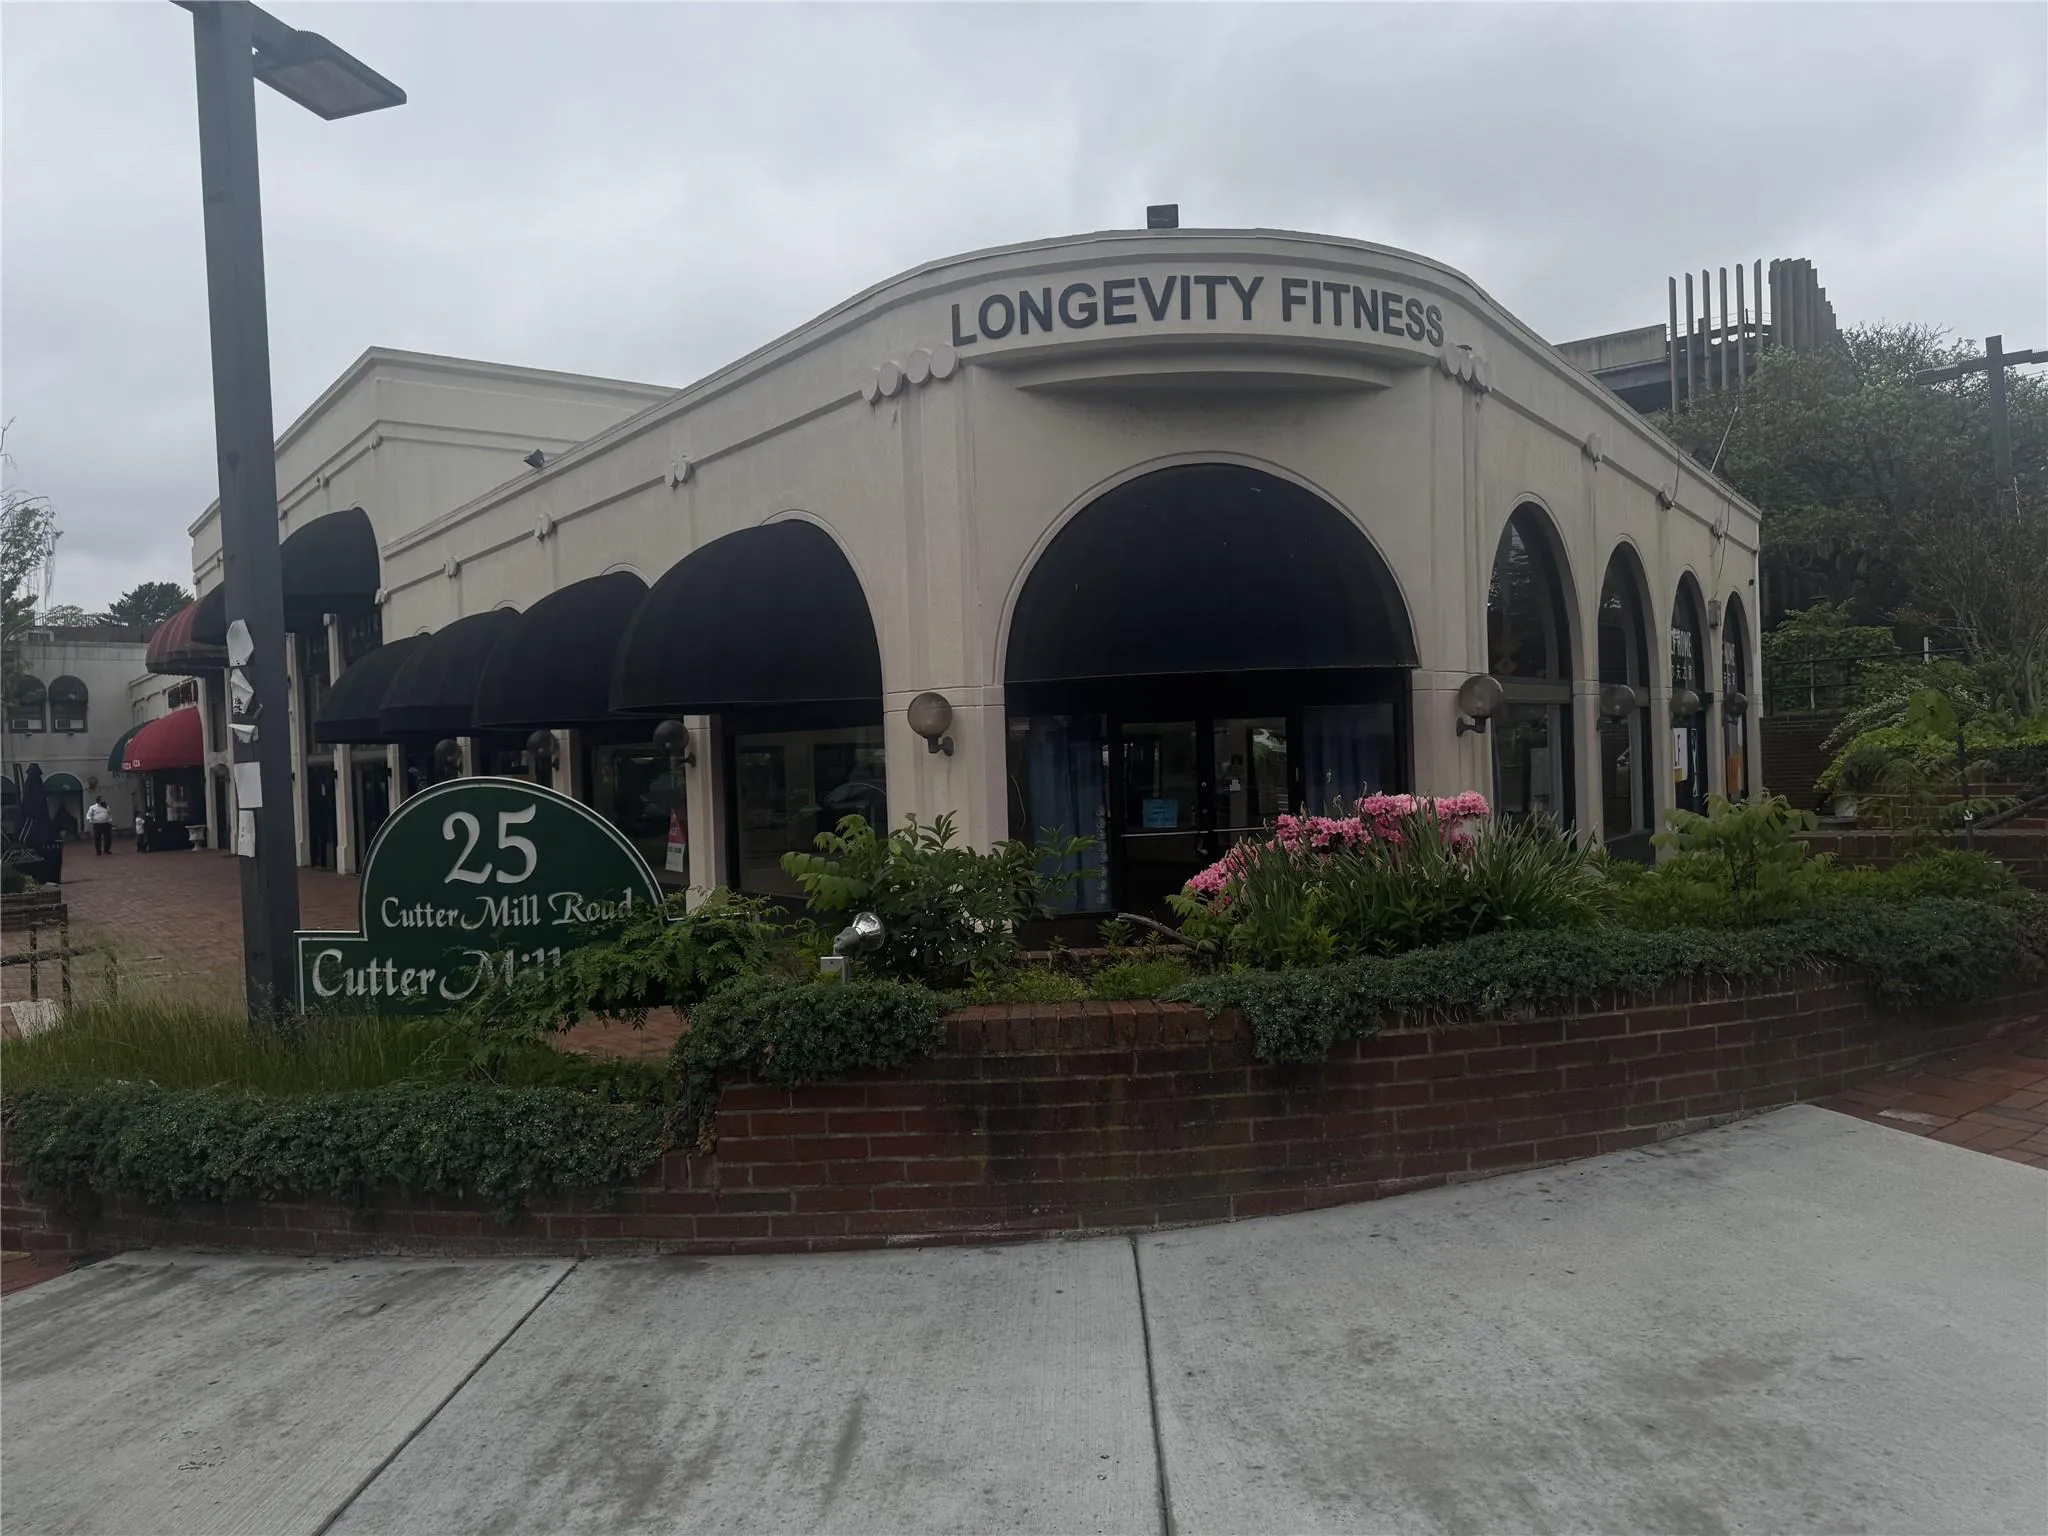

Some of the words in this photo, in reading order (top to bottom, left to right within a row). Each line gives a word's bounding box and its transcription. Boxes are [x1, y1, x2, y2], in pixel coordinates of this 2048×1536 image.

[951, 275, 1264, 347] LONGEVITY
[1281, 279, 1444, 348] FITNESS
[442, 804, 538, 883] 25
[381, 896, 459, 928] Cutter
[461, 895, 541, 930] Mill
[548, 887, 634, 926] Road
[312, 948, 436, 997] Cutter
[439, 947, 561, 1000] Ml
